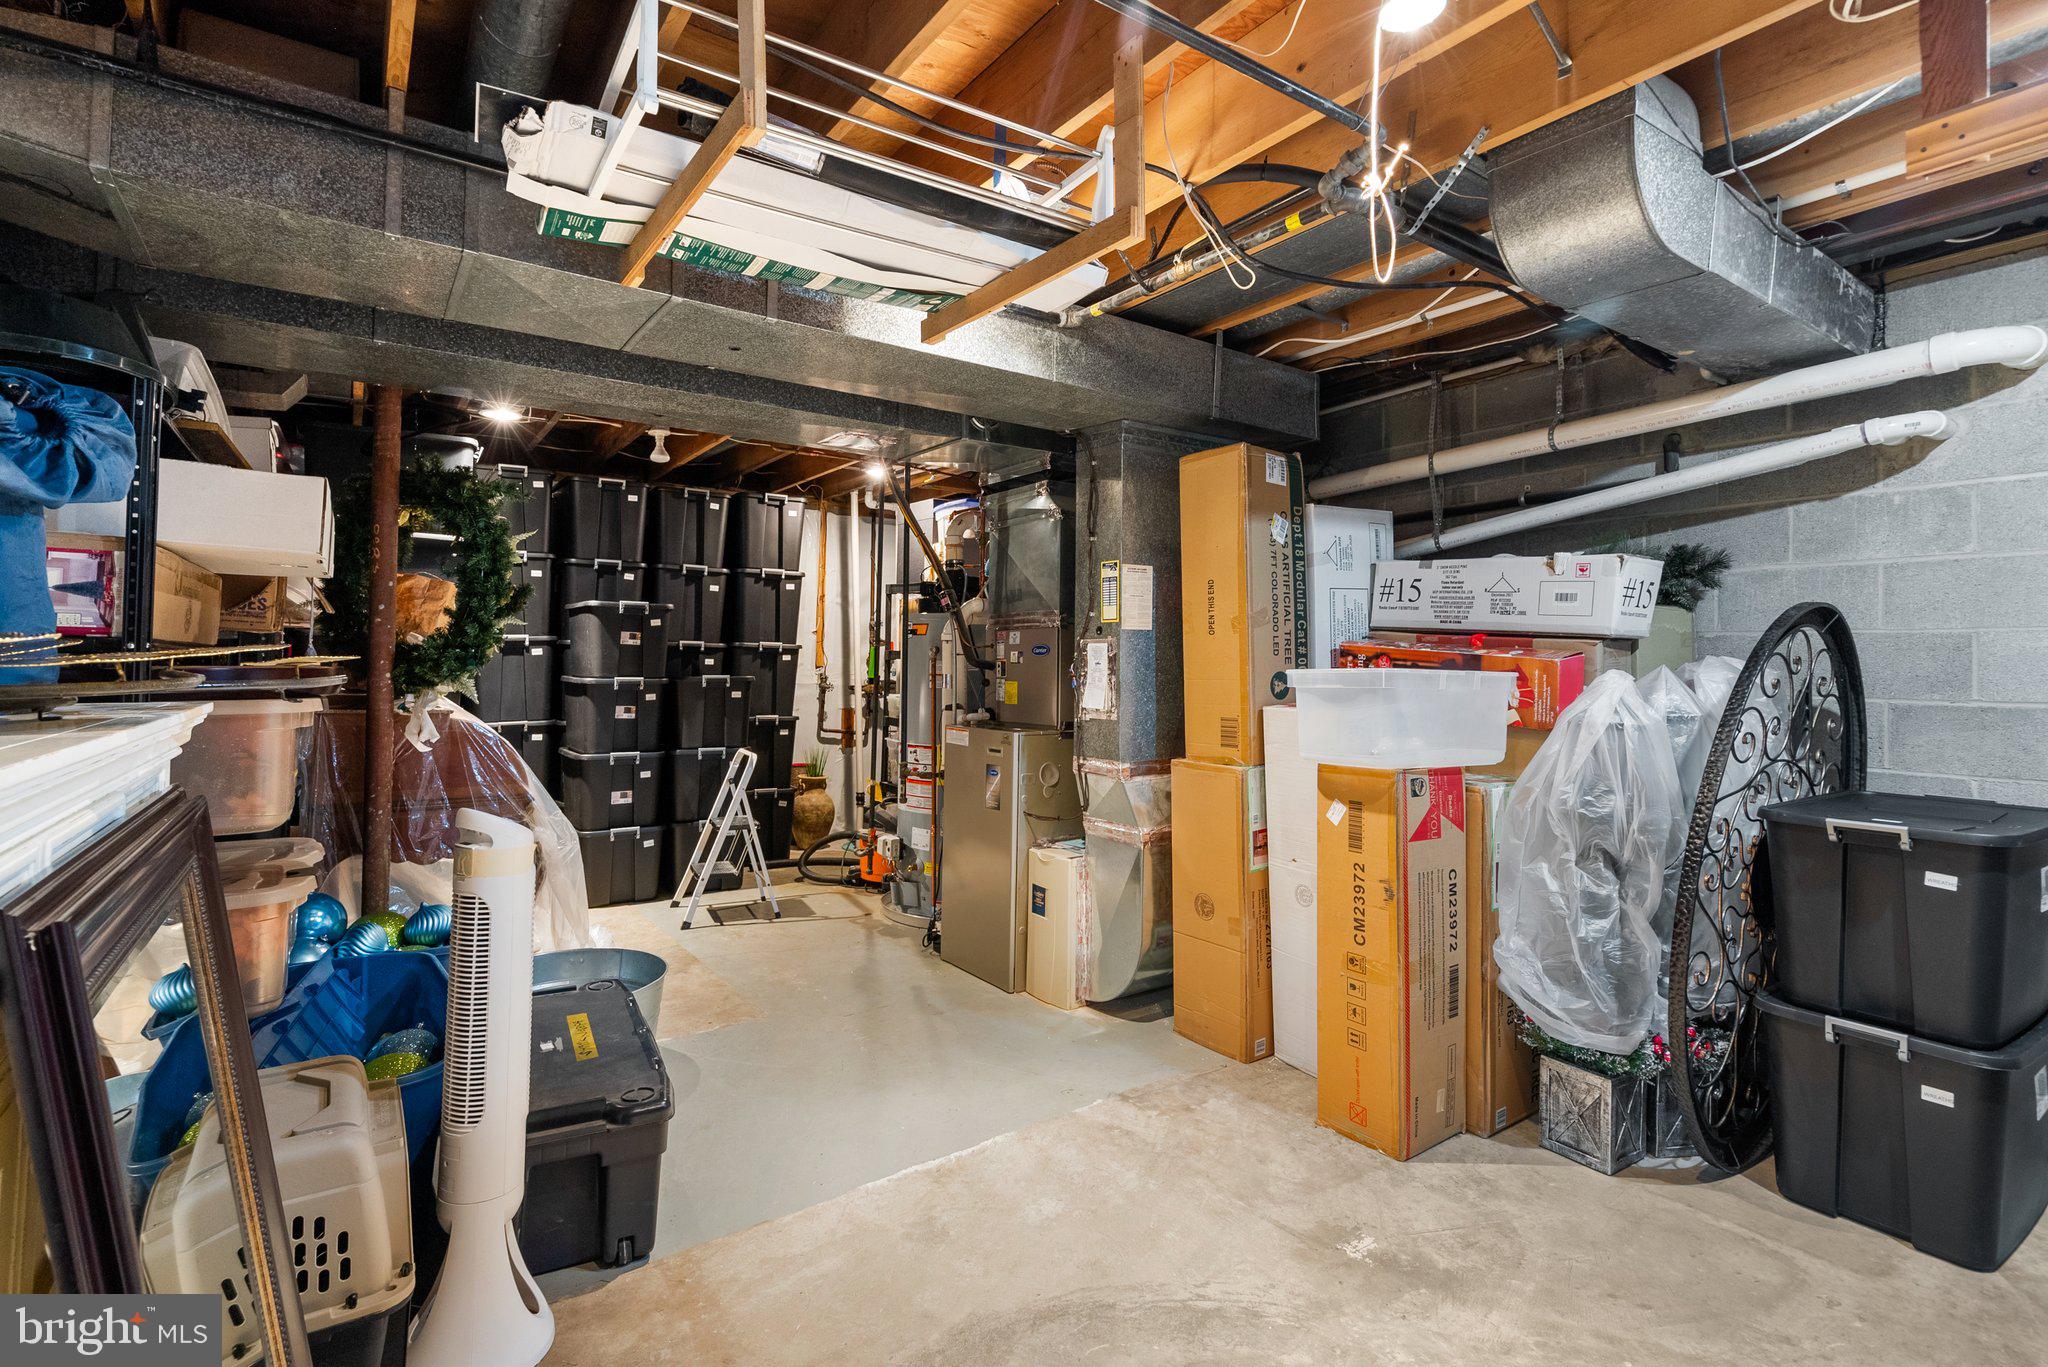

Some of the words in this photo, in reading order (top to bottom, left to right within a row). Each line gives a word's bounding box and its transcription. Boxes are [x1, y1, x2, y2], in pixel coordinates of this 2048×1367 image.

[1271, 571, 1279, 632] COLORADO
[1282, 552, 1292, 626] ARTIFICIAL
[1296, 560, 1306, 617] Modular
[1380, 578, 1422, 602] #15
[1622, 578, 1655, 609] #15
[1284, 630, 1292, 665] TREE
[1428, 769, 1436, 806] THANK
[1352, 862, 1367, 946] CM23972
[1448, 868, 1458, 953] CM23972
